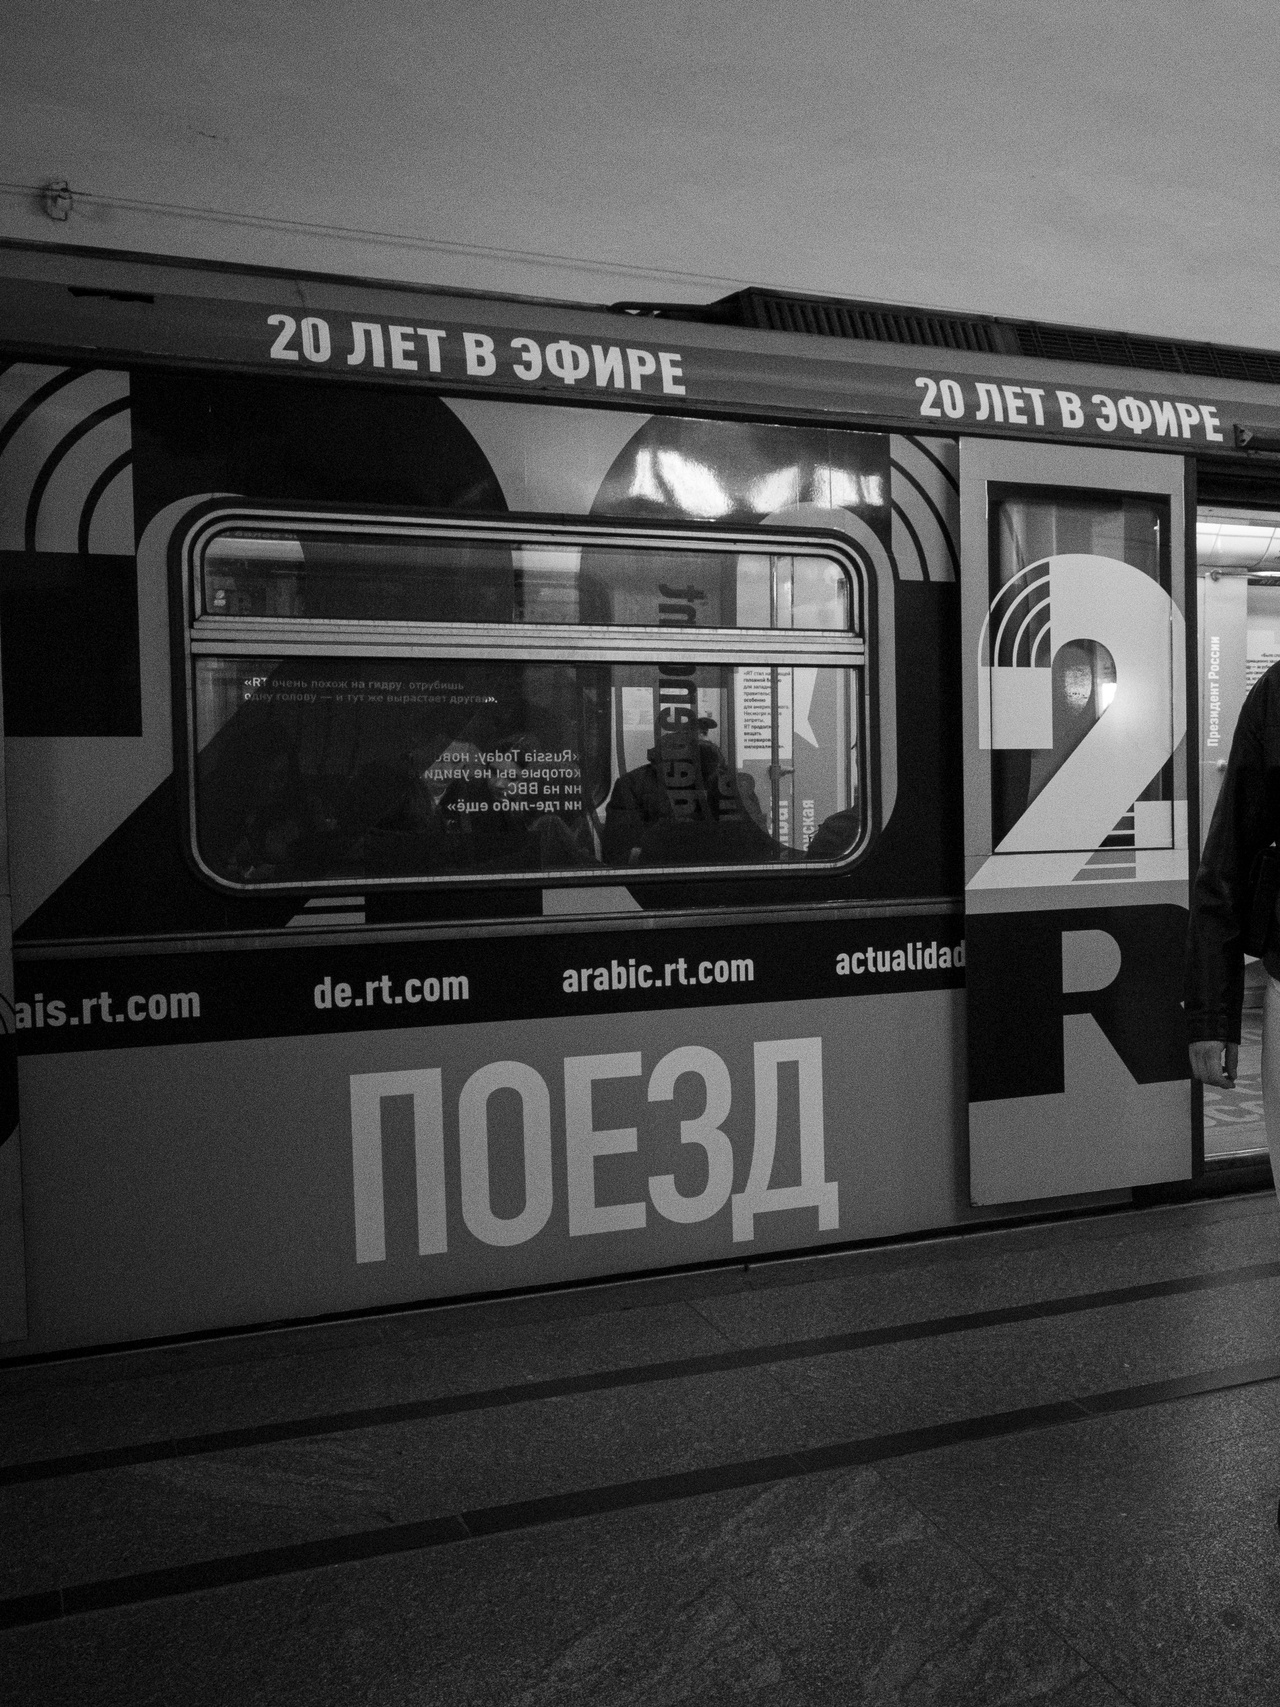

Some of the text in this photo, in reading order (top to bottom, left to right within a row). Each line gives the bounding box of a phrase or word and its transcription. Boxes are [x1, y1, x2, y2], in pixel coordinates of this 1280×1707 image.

[268, 313, 687, 396] 20 ЛЕТ В ЭФИРЕ
[914, 376, 1224, 442] 20 ЛЕТ В ЭФИРЕ
[271, 679, 308, 689] очень
[310, 679, 348, 689] похож
[350, 680, 366, 689] на
[408, 680, 465, 692] отрубишь
[275, 692, 317, 703] голову
[386, 693, 448, 704] вырастает
[1207, 636, 1222, 747] Президент России
[14, 939, 966, 1029] ais.rt.com de.rt.com arabic.rt.com actualidad
[349, 1036, 840, 1263] ПОЕЗД
